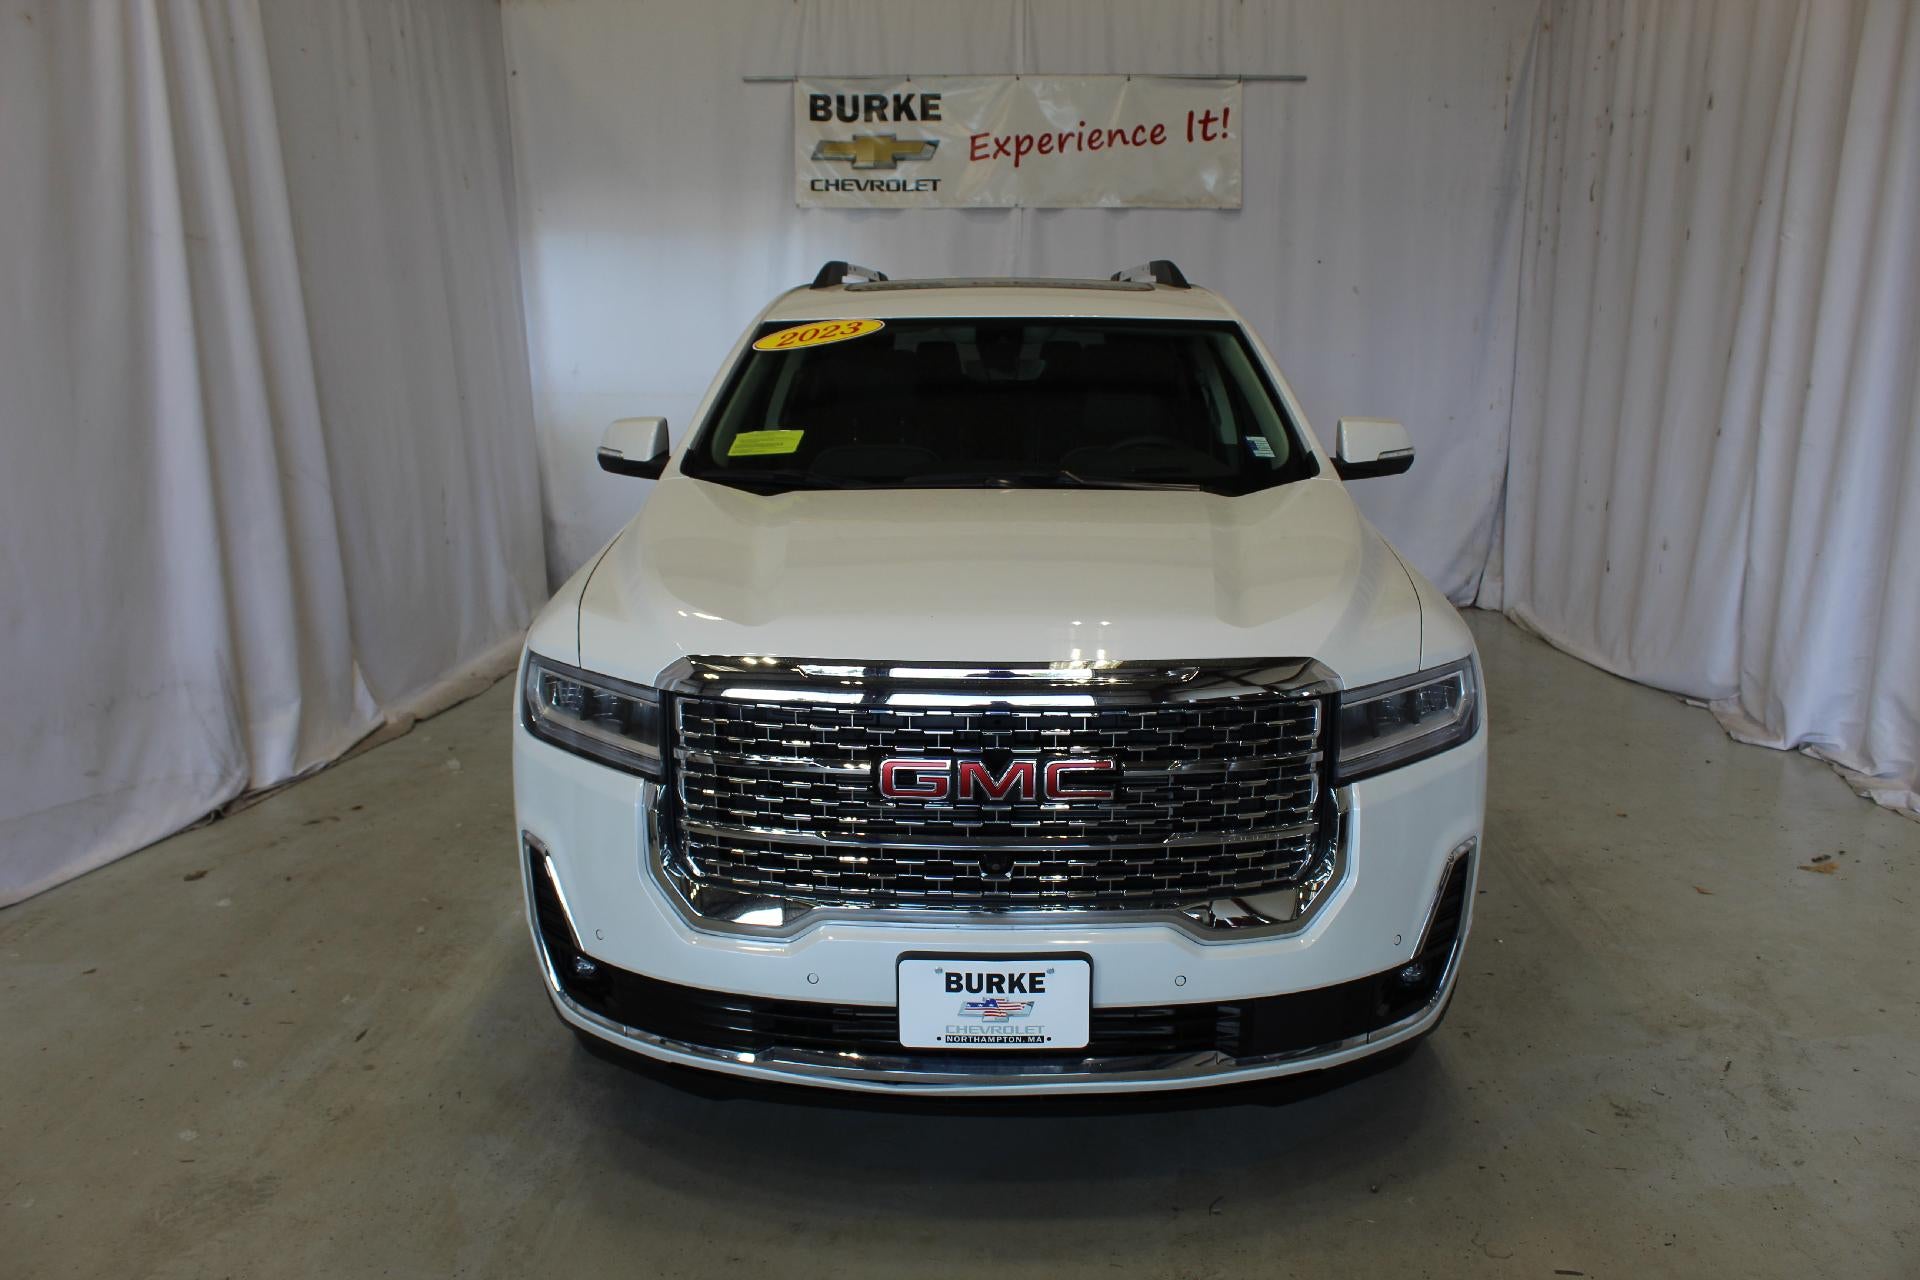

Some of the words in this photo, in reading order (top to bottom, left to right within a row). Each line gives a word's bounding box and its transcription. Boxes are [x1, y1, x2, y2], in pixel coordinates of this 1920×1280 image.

[809, 94, 942, 122] BURKE
[969, 122, 1167, 167] Experience
[1186, 107, 1231, 143] It!
[810, 179, 941, 192] CHEVROLET
[776, 321, 863, 347] 2023
[880, 758, 1116, 800] GMC
[945, 973, 1046, 994] BURKE
[945, 1025, 1045, 1034] CHEVROLET
